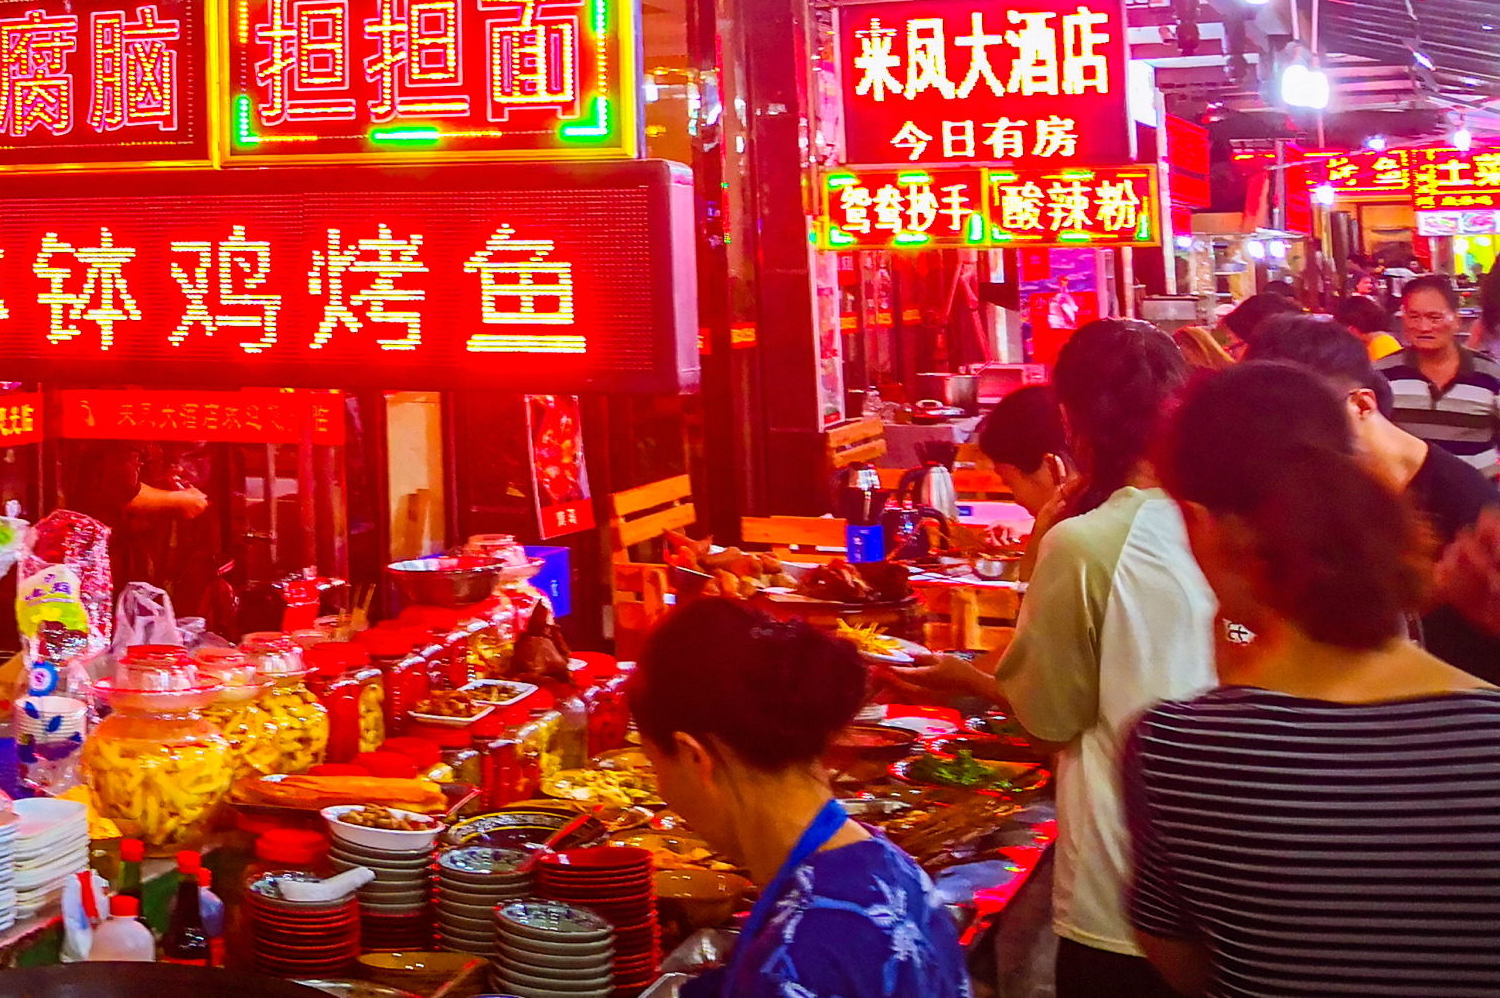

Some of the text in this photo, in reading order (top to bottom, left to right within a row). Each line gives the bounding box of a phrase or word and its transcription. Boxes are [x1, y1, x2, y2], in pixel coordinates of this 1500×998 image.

[855, 6, 1110, 102] 来凤大酒店
[889, 114, 1079, 161] 今日有房
[840, 183, 973, 234] 鸳鸯抄手
[999, 179, 1141, 232] 酸辣粉
